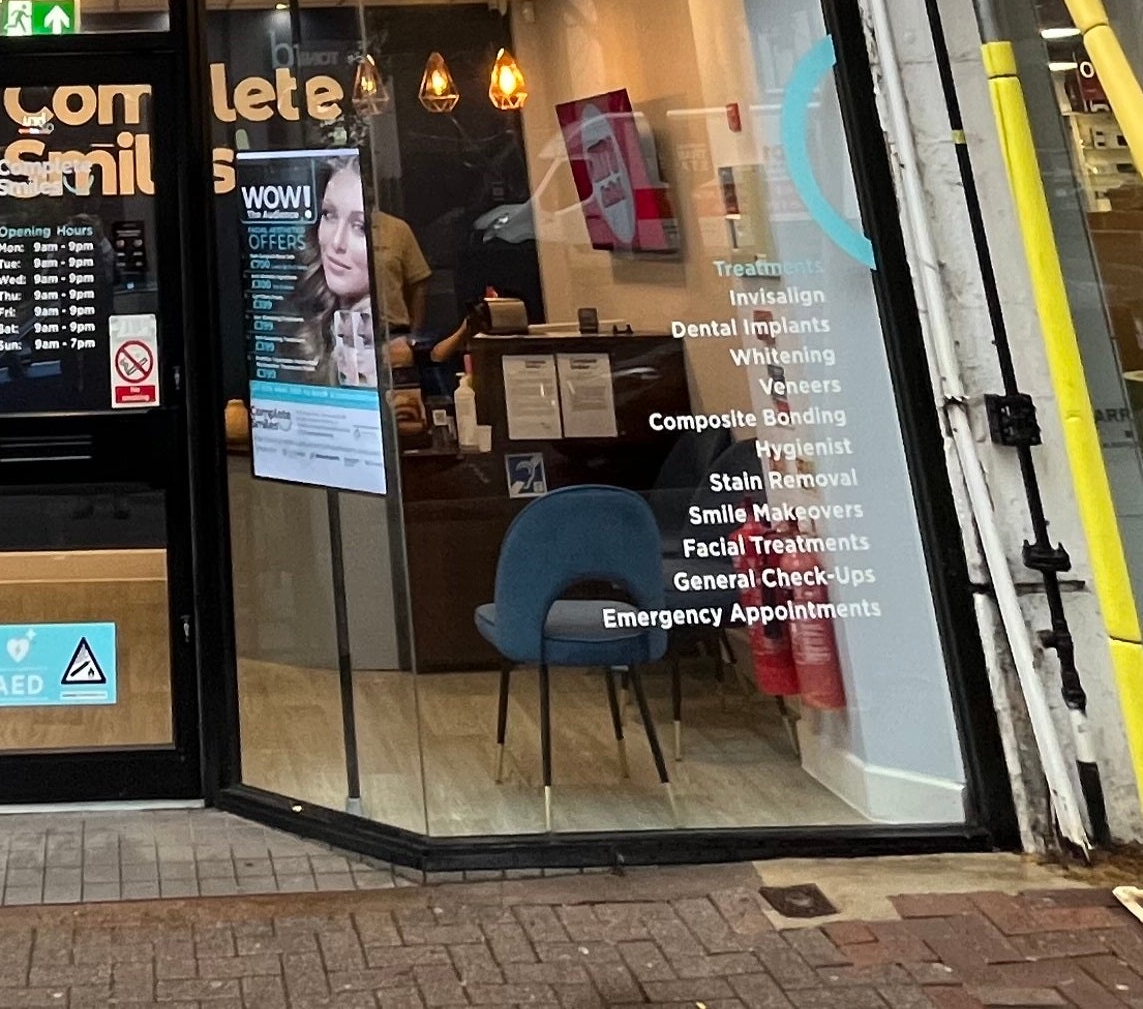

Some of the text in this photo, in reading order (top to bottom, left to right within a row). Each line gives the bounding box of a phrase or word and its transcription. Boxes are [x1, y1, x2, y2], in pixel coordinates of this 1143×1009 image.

[241, 185, 313, 219] WOW!
[56, 225, 94, 237] Hours
[33, 242, 58, 252] 9am
[68, 241, 93, 252] 9pm
[248, 234, 307, 250] OFFERS
[33, 258, 58, 268] 9am
[68, 257, 94, 268] 9pm
[713, 258, 825, 278] Treatments
[33, 274, 58, 284] 9am
[68, 273, 94, 284] 9pm
[33, 290, 58, 300] 9am
[69, 289, 94, 300] 9pm
[729, 287, 825, 307] Invisalign
[34, 306, 59, 316] 9am
[69, 305, 95, 316] 9pm
[34, 323, 59, 333] 9am
[69, 322, 95, 333] 9pm
[671, 316, 831, 339] Dental Implants
[34, 339, 59, 349] 9am
[70, 338, 95, 350] 7pm
[729, 346, 836, 367] Whitening
[759, 377, 842, 396] Veneers
[649, 407, 848, 432] Composite Bonding
[755, 437, 854, 462] Hygienist
[709, 468, 858, 492] Stain Removal
[689, 502, 864, 525] Smile Makeovers
[683, 533, 870, 558] Facial Treatments
[673, 566, 877, 592] General Check-Ups
[602, 599, 882, 630] Emergency Appointments
